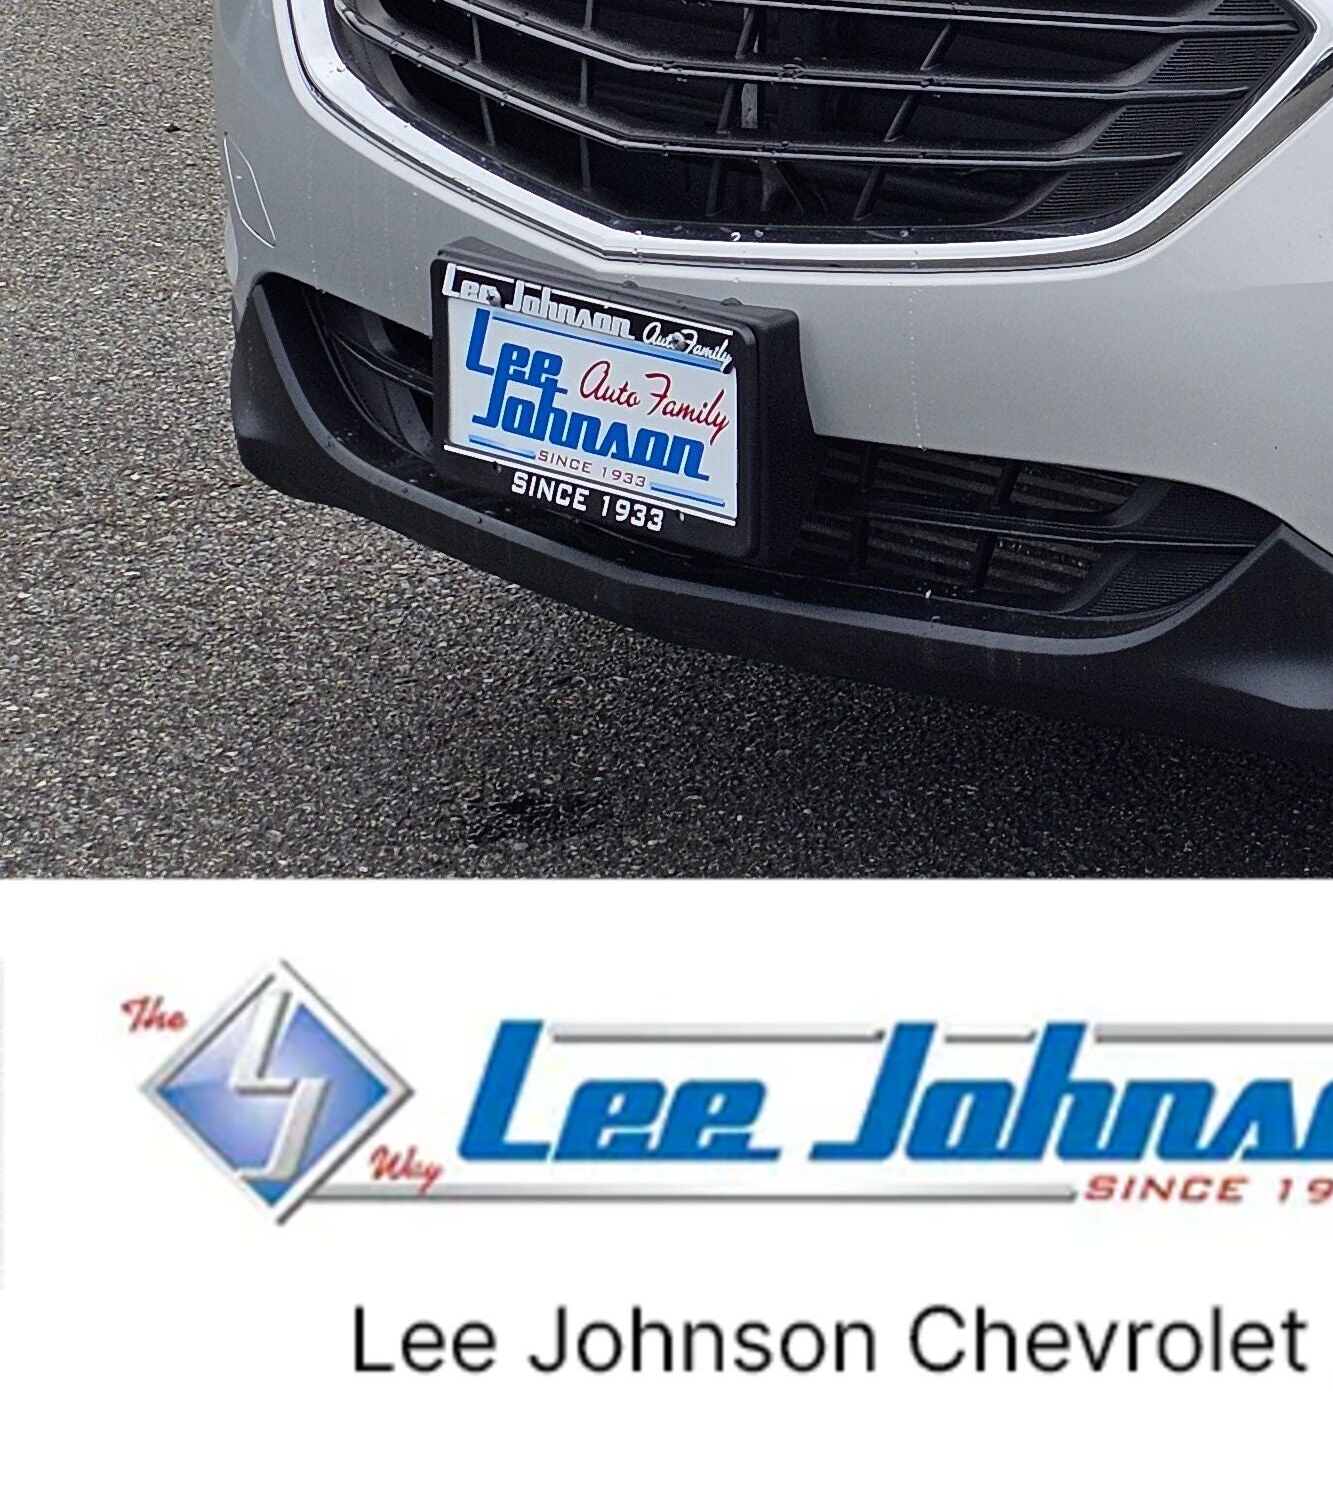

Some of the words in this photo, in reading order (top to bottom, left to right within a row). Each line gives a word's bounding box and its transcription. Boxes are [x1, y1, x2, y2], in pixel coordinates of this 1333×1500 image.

[466, 308, 568, 394] Lee
[505, 280, 635, 341] Johnson
[642, 321, 682, 350] Aut
[681, 329, 733, 372] Family
[471, 368, 710, 482] Johnson
[579, 360, 641, 408] Auto
[645, 372, 730, 446] Family
[511, 471, 591, 512] SINCE
[601, 494, 665, 533] 1933
[537, 449, 593, 474] SINCE
[601, 466, 646, 489] 1933
